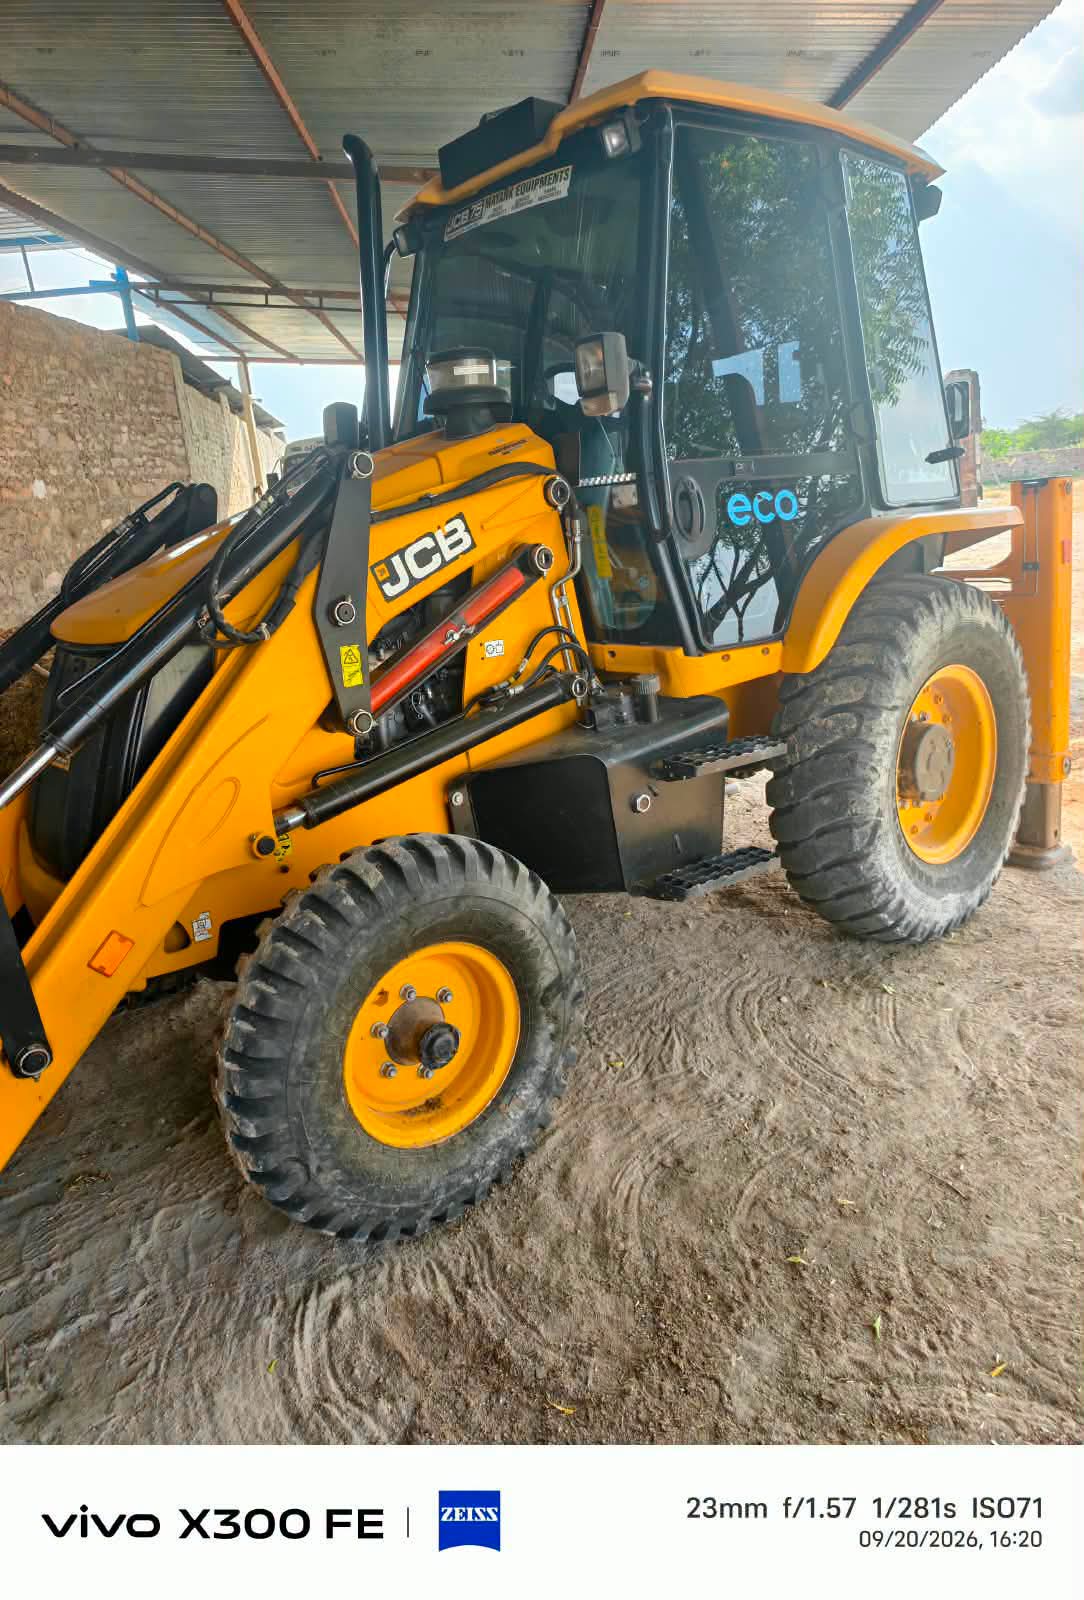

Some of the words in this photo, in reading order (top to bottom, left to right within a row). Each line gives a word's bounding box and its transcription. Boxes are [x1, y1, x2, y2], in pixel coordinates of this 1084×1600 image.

[515, 168, 570, 196] EQUIPMENTS
[727, 489, 798, 526] eco
[382, 518, 472, 597] JCB
